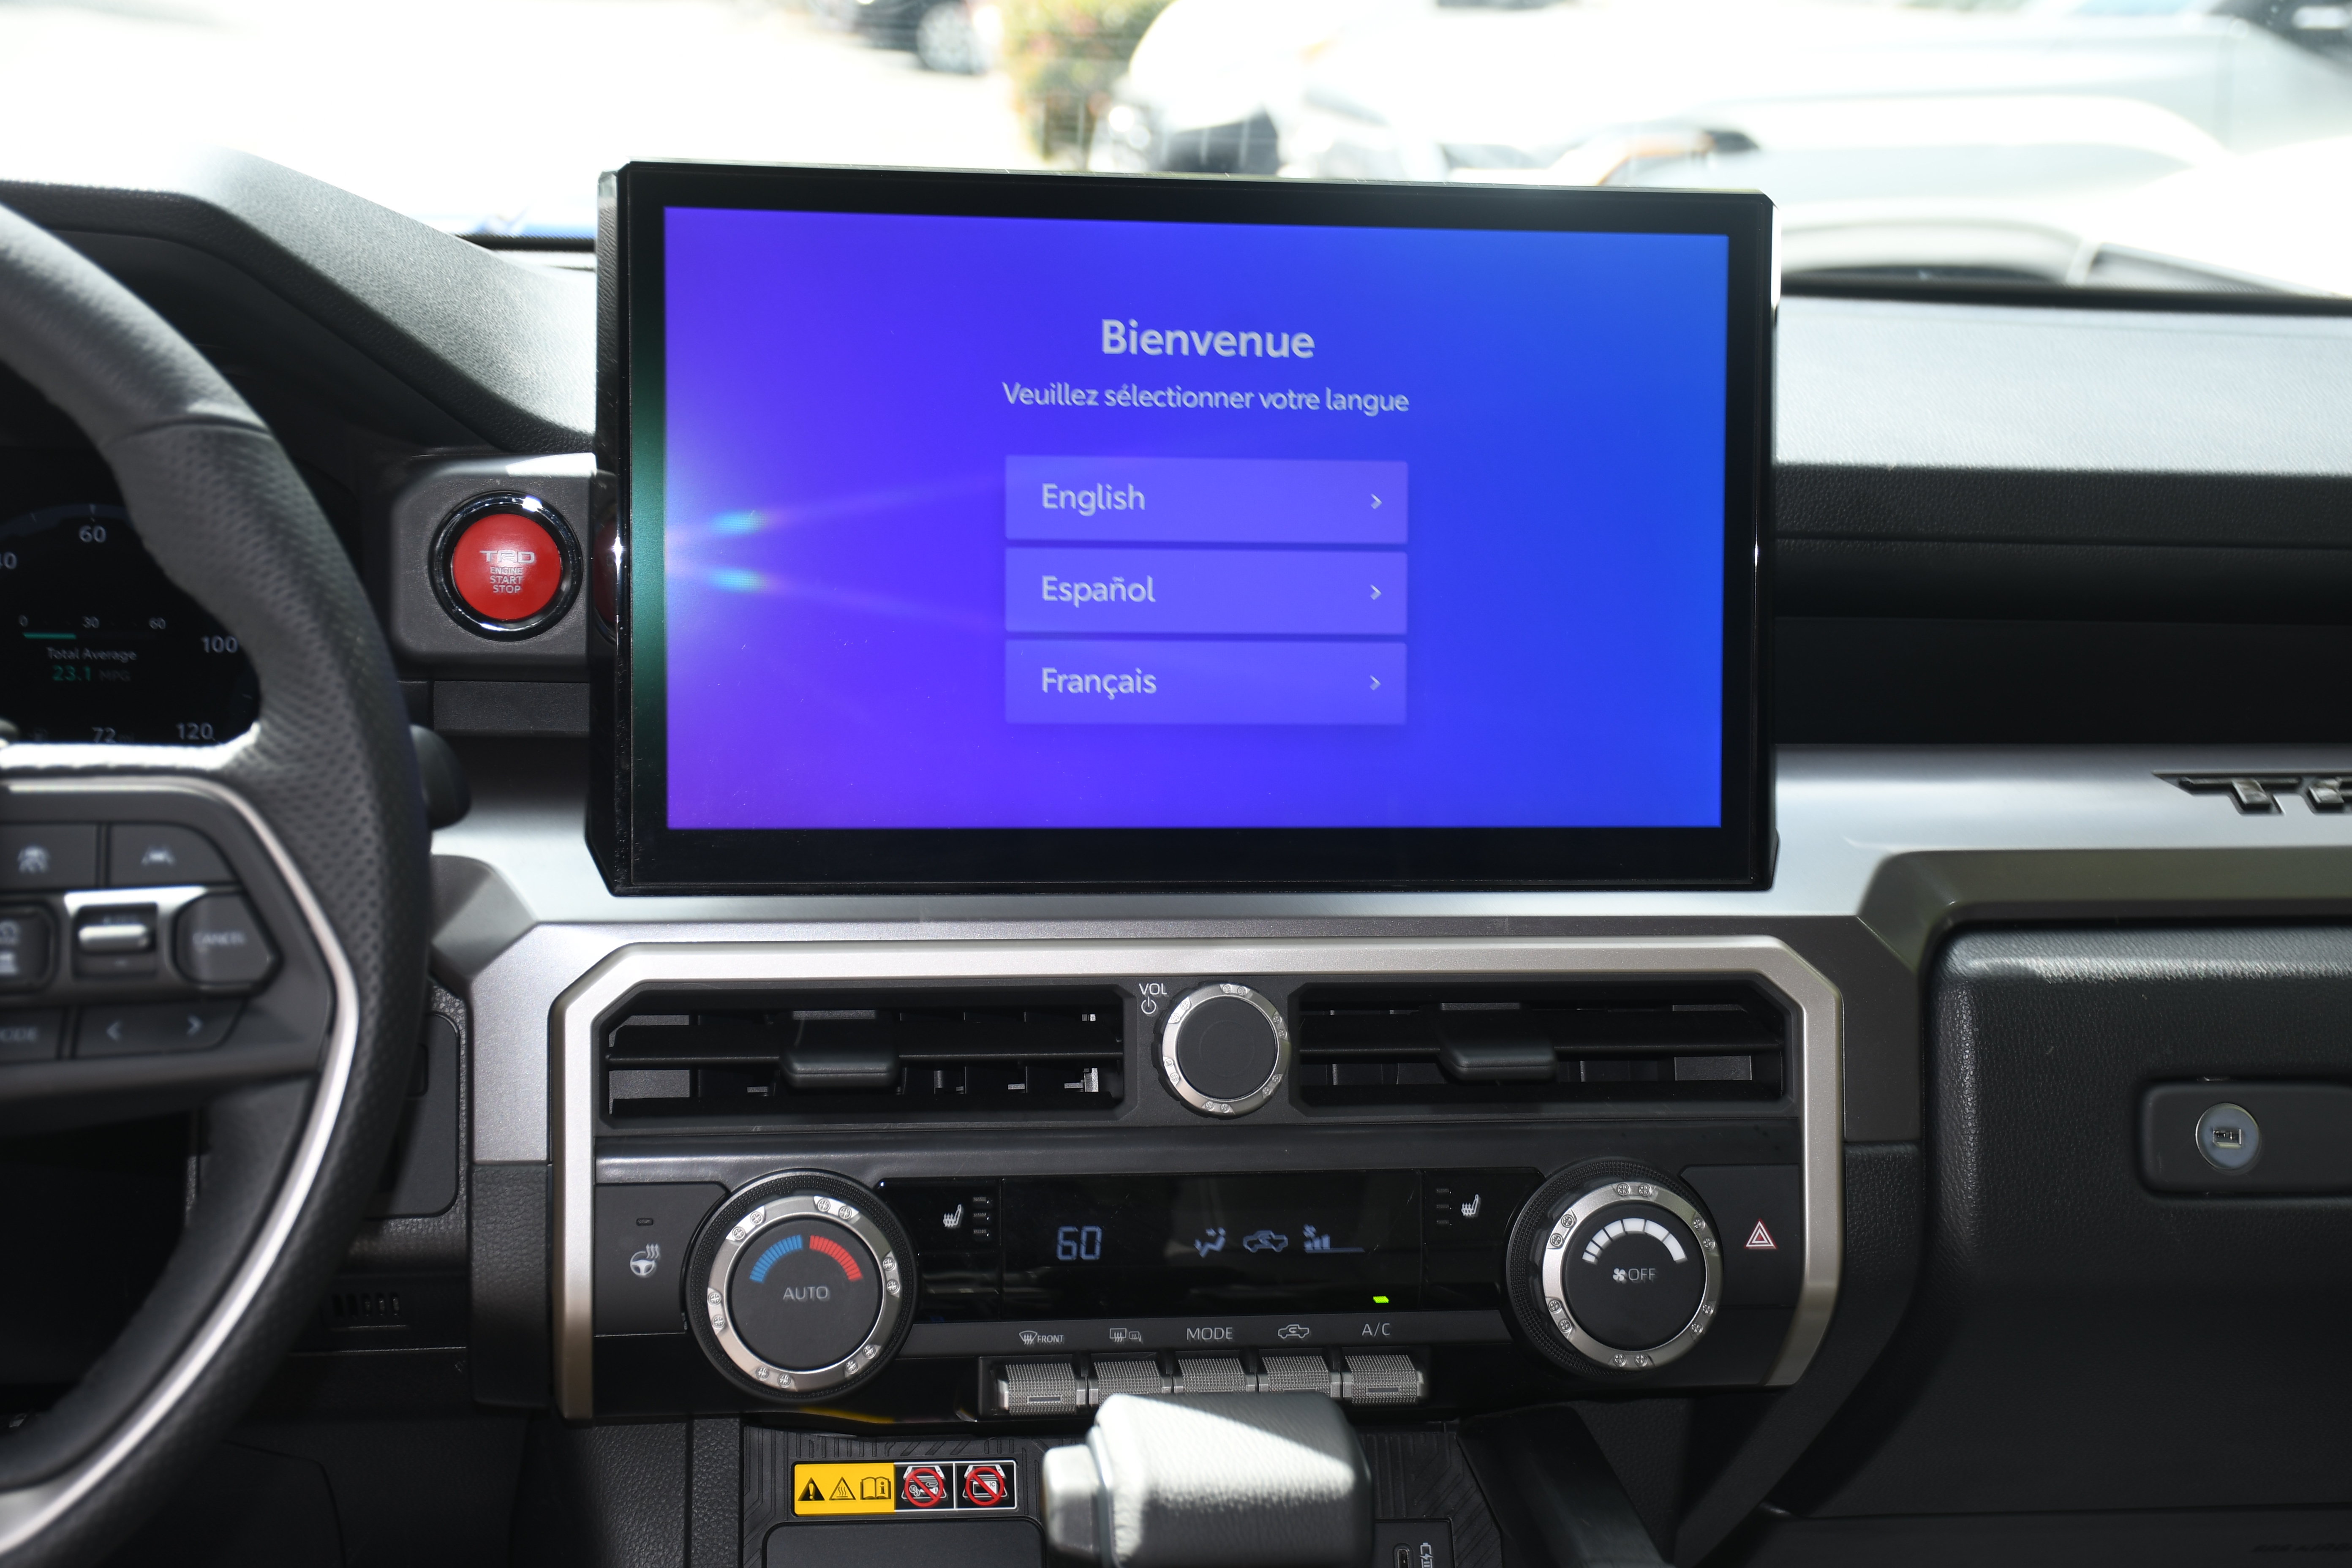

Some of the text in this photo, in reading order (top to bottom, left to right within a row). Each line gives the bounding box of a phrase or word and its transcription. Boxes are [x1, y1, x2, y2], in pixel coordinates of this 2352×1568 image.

[1101, 318, 1315, 359] Bienvenue
[1002, 381, 1410, 417] Veuillez sélectionner votre langue
[1041, 482, 1146, 516] English
[79, 525, 106, 543] 60
[479, 550, 535, 563] TRD
[490, 566, 523, 574] ENGINE
[490, 576, 523, 584] START
[493, 585, 521, 593] STOP
[1041, 575, 1157, 608] Español
[19, 615, 28, 627] 0
[82, 616, 100, 629] 30
[200, 635, 239, 654] 100
[46, 647, 137, 663] Total Average
[52, 664, 91, 682] 23.1
[1041, 667, 1157, 700] Français
[175, 722, 214, 740] 120
[1139, 983, 1168, 995] VOL
[0, 1027, 37, 1041] ODE
[1057, 1225, 1102, 1260] 60
[1628, 1268, 1656, 1281] OFF
[783, 1286, 829, 1300] AUTO
[1186, 1327, 1234, 1340] MODE
[1361, 1323, 1391, 1336] A/C
[1037, 1334, 1064, 1345] FRONT
